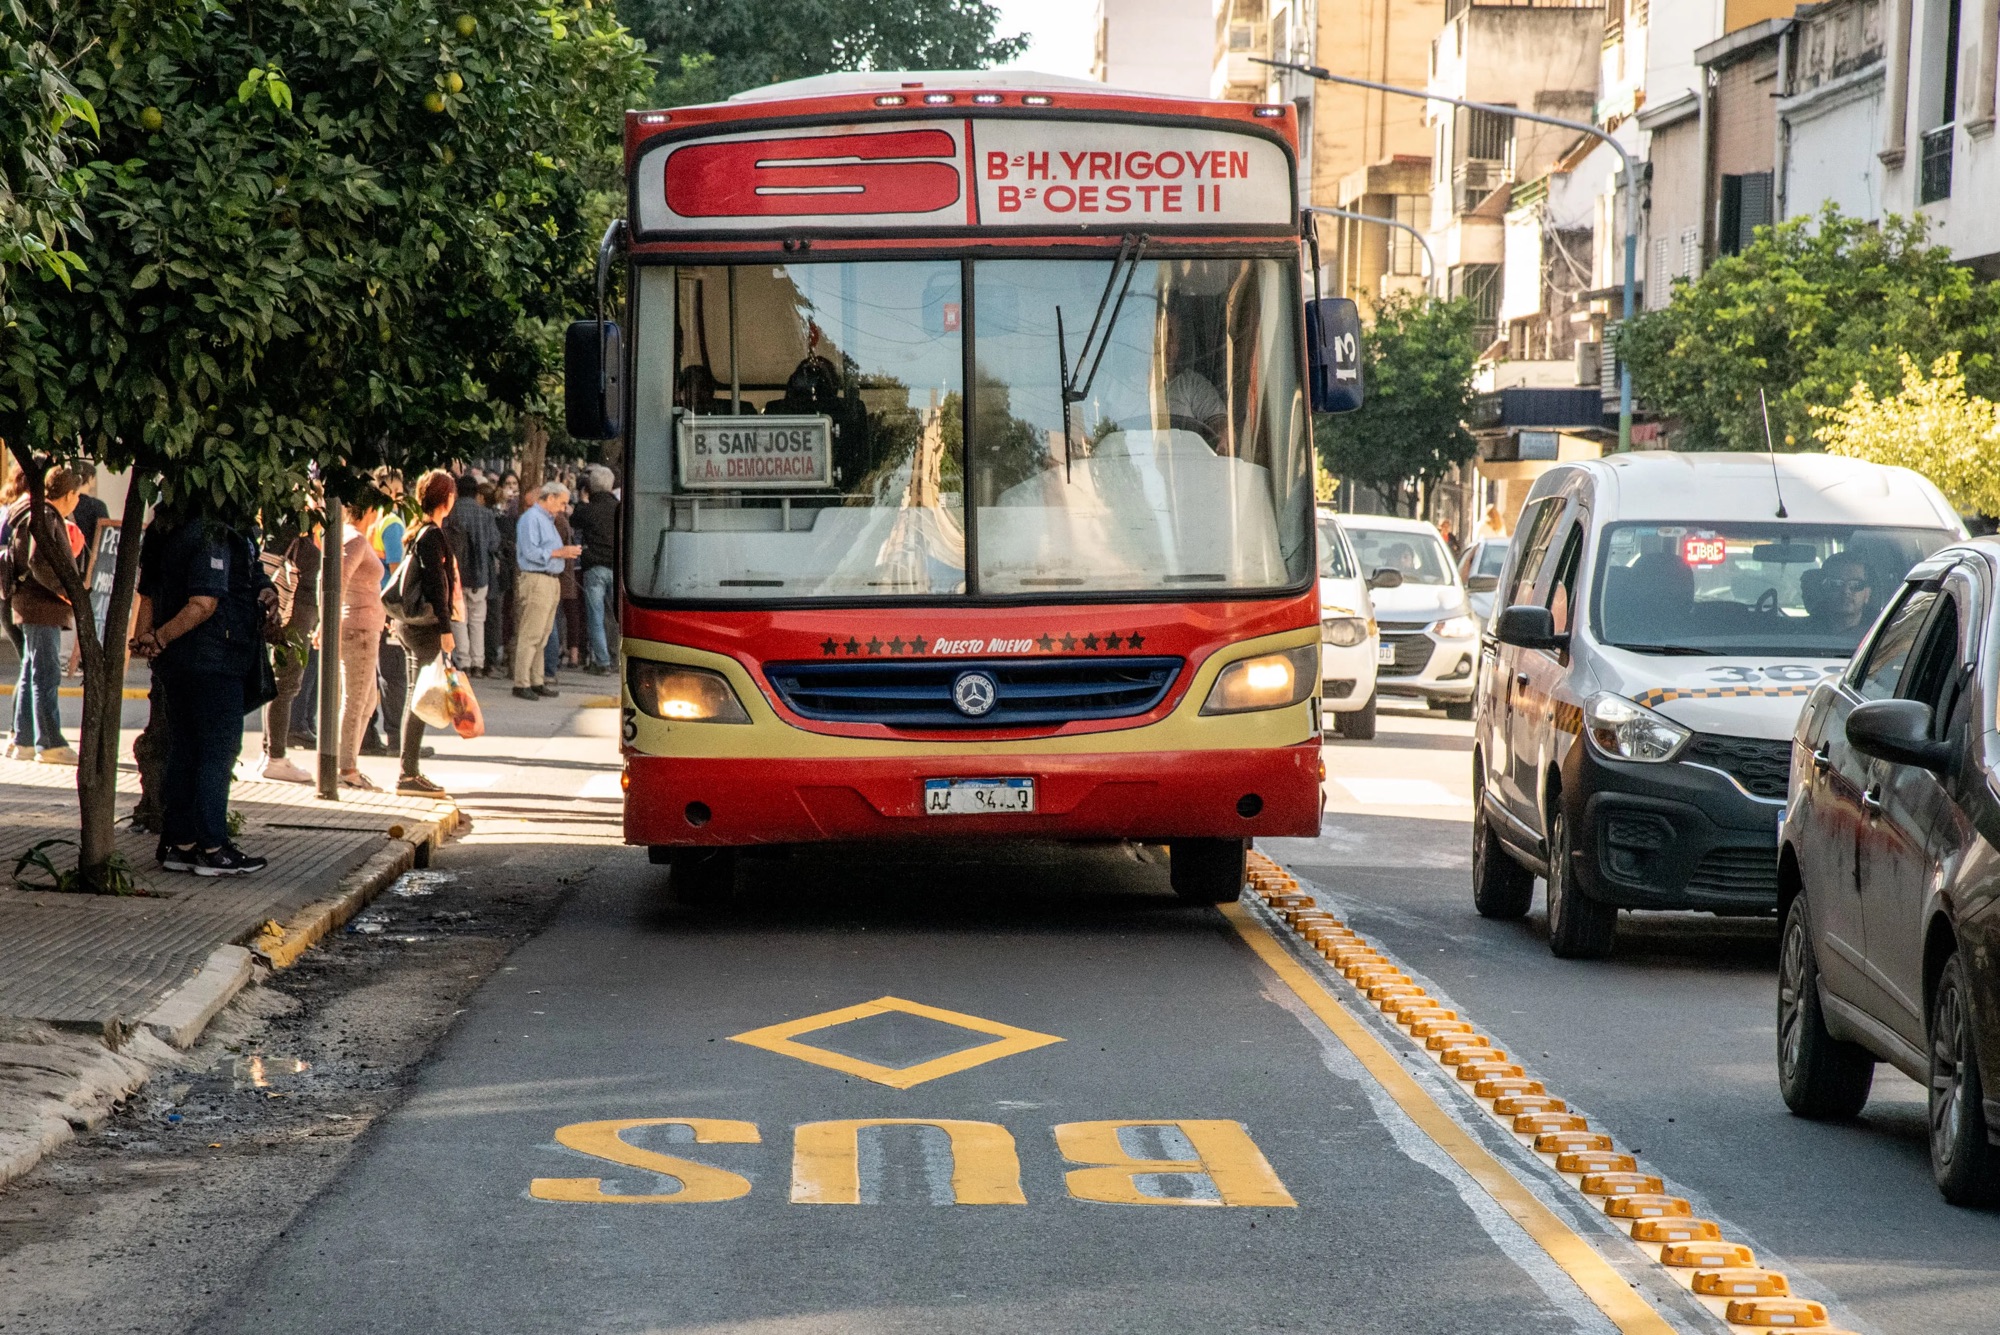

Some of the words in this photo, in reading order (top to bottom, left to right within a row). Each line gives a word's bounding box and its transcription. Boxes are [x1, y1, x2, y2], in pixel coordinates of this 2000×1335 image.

[664, 129, 960, 217] 6
[1043, 184, 1182, 213] OESTE
[1334, 332, 1357, 381] 13
[694, 433, 712, 455] B.
[718, 431, 758, 455] SAN
[764, 430, 813, 453] JOSE
[726, 455, 815, 477] DEMOCRACIA
[987, 637, 1033, 653] NUEVO
[529, 1117, 1298, 1207] BUS
